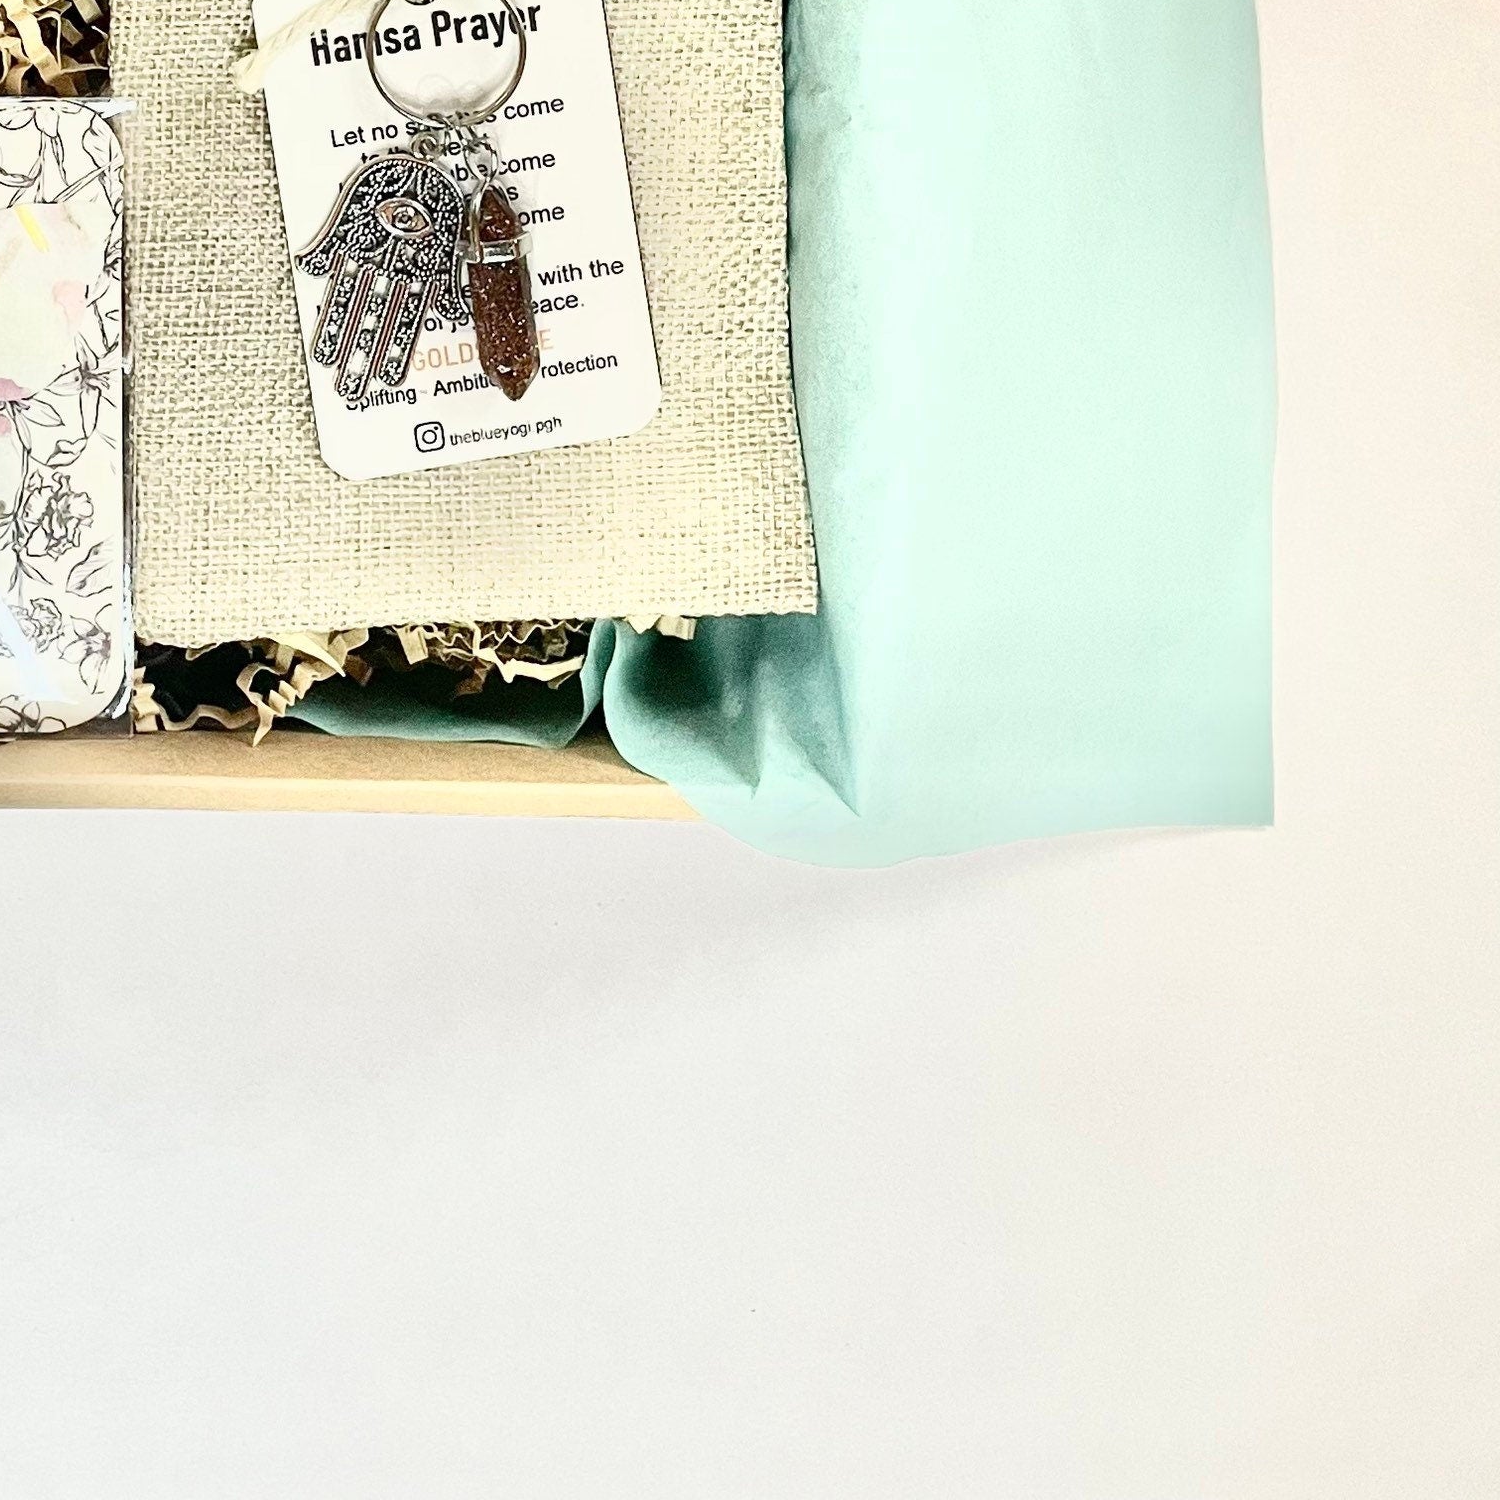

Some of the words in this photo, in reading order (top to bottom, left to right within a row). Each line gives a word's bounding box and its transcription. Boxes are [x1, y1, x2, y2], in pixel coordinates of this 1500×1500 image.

[310, 24, 422, 66] Hamsa
[431, 4, 541, 48] Prayer
[330, 126, 366, 148] Let
[371, 124, 398, 141] no
[503, 97, 564, 121] come
[518, 206, 565, 227] ome
[537, 265, 583, 286] with
[589, 259, 624, 278] the
[533, 294, 585, 314] eace.
[411, 329, 554, 371] GOLDE
[346, 387, 417, 412] plifting
[541, 355, 618, 379] rotection
